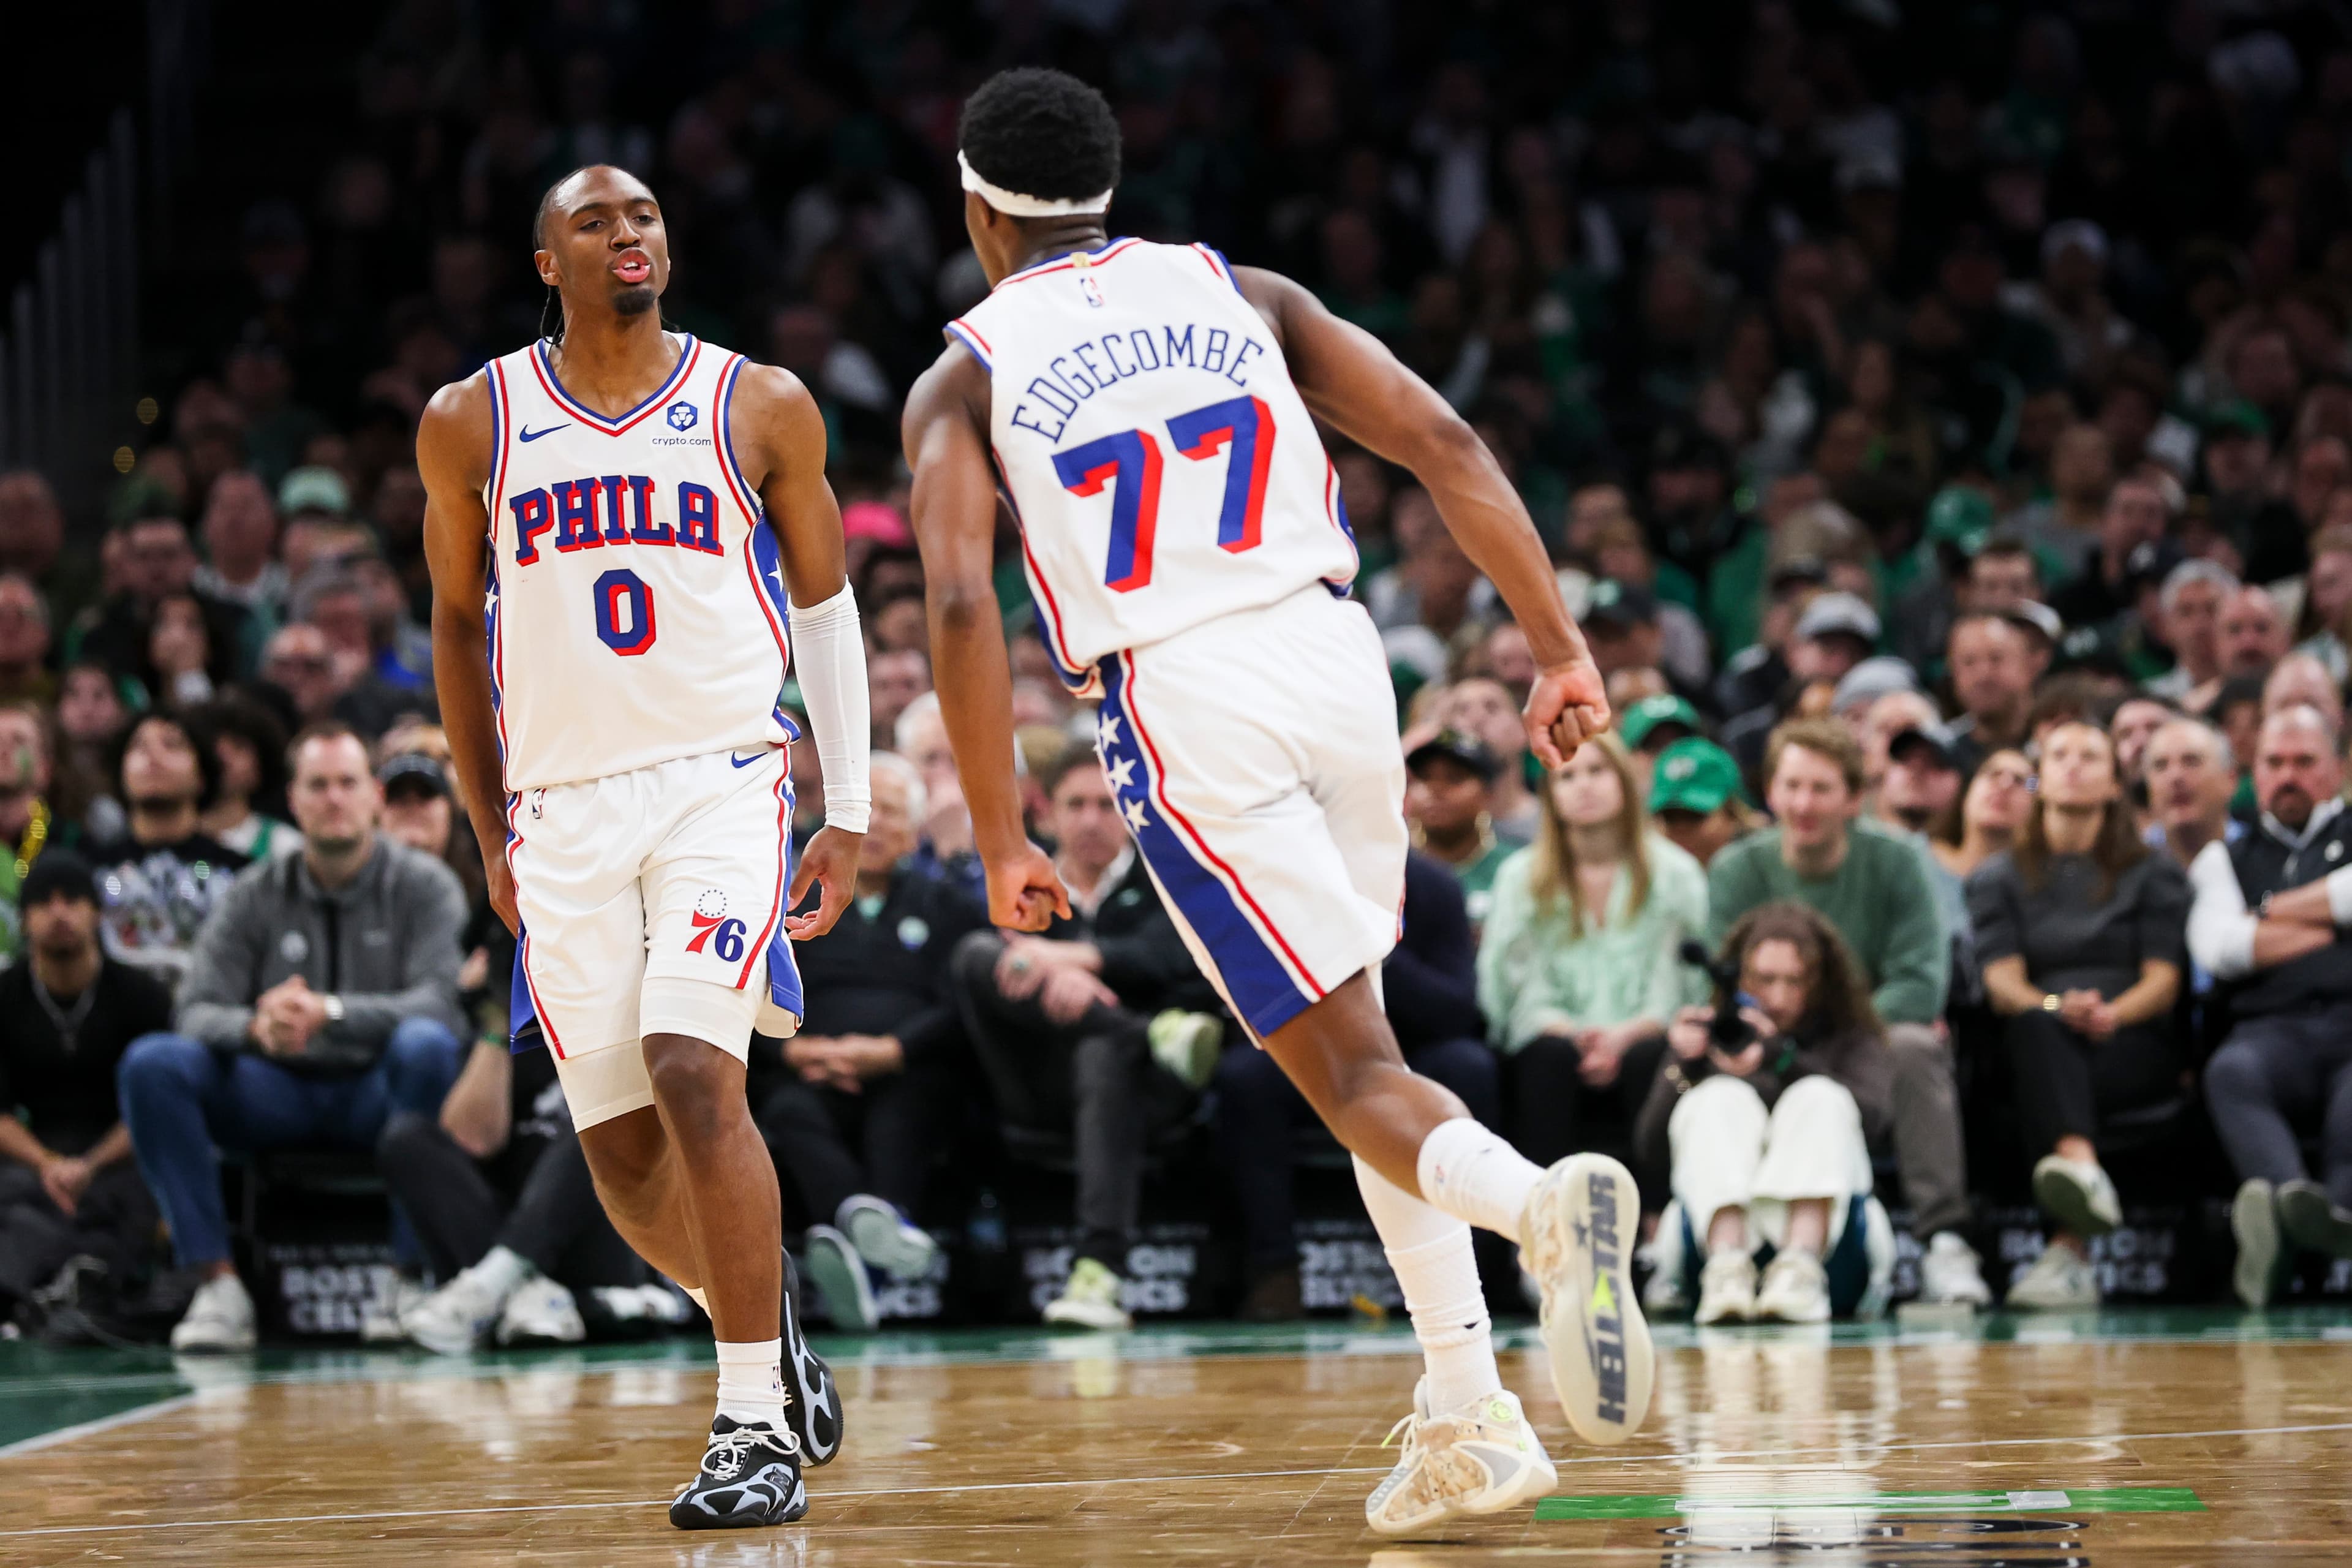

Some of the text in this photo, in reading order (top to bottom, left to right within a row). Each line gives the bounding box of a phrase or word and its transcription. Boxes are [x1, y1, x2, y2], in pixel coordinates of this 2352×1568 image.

[1012, 324, 1264, 444] EDGECOMBE
[652, 437, 711, 446] crypto.com
[509, 475, 724, 567] PHILA
[1050, 394, 1276, 594] 77
[593, 568, 657, 656] 0
[685, 909, 747, 962] 76
